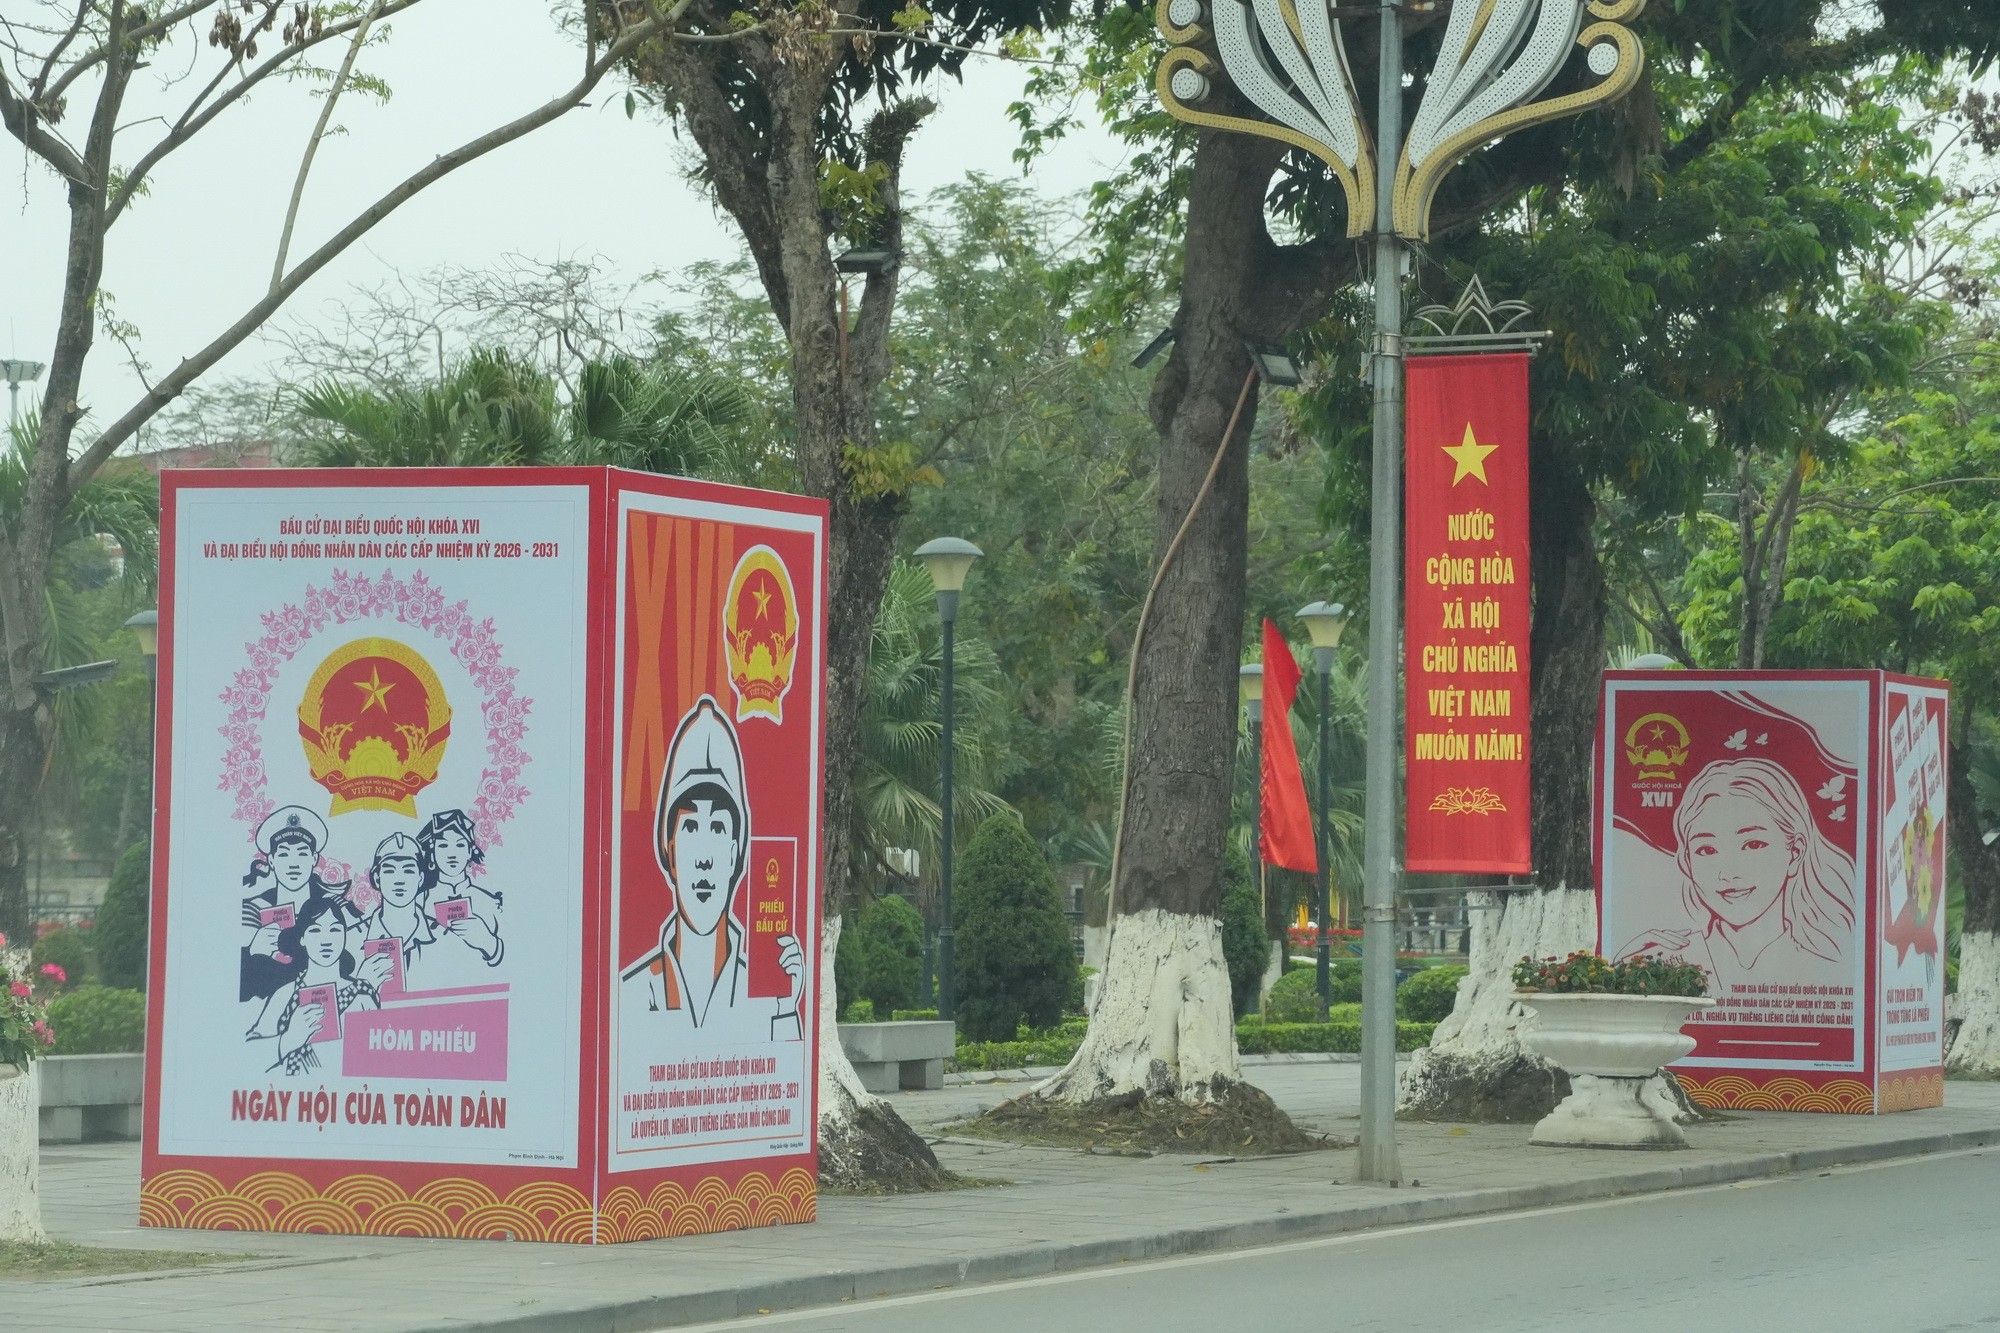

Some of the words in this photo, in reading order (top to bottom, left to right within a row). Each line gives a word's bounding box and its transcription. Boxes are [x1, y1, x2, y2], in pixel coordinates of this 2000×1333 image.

[280, 515, 302, 535] BẦU
[305, 514, 321, 535] CỬ
[323, 520, 342, 538] ĐẠI
[345, 514, 370, 535] BIỂU
[374, 515, 403, 536] QUỐC
[406, 517, 425, 538] HỘI
[429, 516, 458, 535] KHÓA
[462, 519, 480, 535] XVI
[1448, 508, 1494, 541] NƯỚC
[204, 541, 218, 558] VÀ
[220, 543, 238, 561] ĐẠI
[242, 538, 266, 558] BIỂU
[270, 541, 288, 561] HỘI
[291, 539, 321, 558] ĐỒNG
[324, 541, 355, 558] NHÂN
[358, 541, 382, 558] DÂN
[385, 540, 407, 558] CÁC
[410, 538, 432, 558] CẤP
[436, 540, 473, 561] NHIỆM
[476, 540, 490, 558] KỲ
[494, 542, 521, 558] 2026
[532, 542, 558, 558] 2031
[1426, 552, 1474, 590] CỘNG
[1480, 551, 1514, 584] HÒA
[1442, 597, 1465, 628] XÃ
[1470, 596, 1500, 634] HỘI
[1422, 637, 1458, 673] CHỦ
[1464, 640, 1518, 672] NGHĨA
[1428, 684, 1466, 722] VIỆT
[1470, 690, 1510, 716] NAM
[1416, 728, 1469, 761] MUÔN
[1474, 728, 1522, 760] NĂM!
[351, 784, 372, 796] VIỆT
[374, 786, 396, 796] NAM
[1641, 792, 1674, 807] XVI
[760, 897, 784, 913] PHIẾU
[756, 916, 773, 932] BẦU
[776, 915, 788, 932] CỬ
[1706, 1010, 1726, 1022] NGHĨA
[1728, 1012, 1737, 1024] VỤ
[1738, 1011, 1762, 1022] THIÊNG
[1764, 1012, 1784, 1023] LIÊNG
[1786, 1010, 1800, 1024] CỦA
[1816, 1012, 1834, 1024] CÔNG
[368, 1024, 414, 1050] HÒM
[420, 1024, 476, 1053] PHIẾU
[650, 1064, 666, 1082] THAM
[666, 1064, 676, 1081] GIA
[690, 1056, 700, 1079] CỬ
[700, 1062, 710, 1082] ĐẠI
[710, 1054, 724, 1078] BIỂU
[724, 1054, 740, 1078] QUỐC
[740, 1056, 750, 1079] HỘI
[751, 1055, 766, 1074] KHÓA
[766, 1057, 776, 1074] XVI
[232, 1084, 292, 1122] NGÀY
[298, 1084, 337, 1132] HỘI
[345, 1084, 386, 1124] CỦA
[394, 1088, 452, 1126] TOÀN
[460, 1090, 507, 1129] DÂN
[624, 1091, 632, 1112] VÀ
[632, 1094, 642, 1114] ĐẠI
[644, 1086, 657, 1110] BIỂU
[658, 1088, 668, 1112] HỘI
[686, 1086, 702, 1106] NHÂN
[702, 1085, 714, 1106] DÂN
[716, 1084, 728, 1104] CÁC
[728, 1080, 740, 1103] CẤP
[740, 1082, 759, 1105] NHIỆM
[760, 1081, 768, 1100] KỲ
[768, 1083, 782, 1100] 2026
[786, 1082, 798, 1098] 2031
[632, 1118, 638, 1139] LÀ
[672, 1114, 689, 1136] NGHĨA
[690, 1116, 698, 1136] VỤ
[699, 1112, 718, 1132] THIÊNG
[720, 1110, 736, 1130] LIÊNG
[737, 1105, 748, 1129] CỦA
[762, 1106, 776, 1126] CÔNG
[778, 1106, 791, 1125] DÂN!
